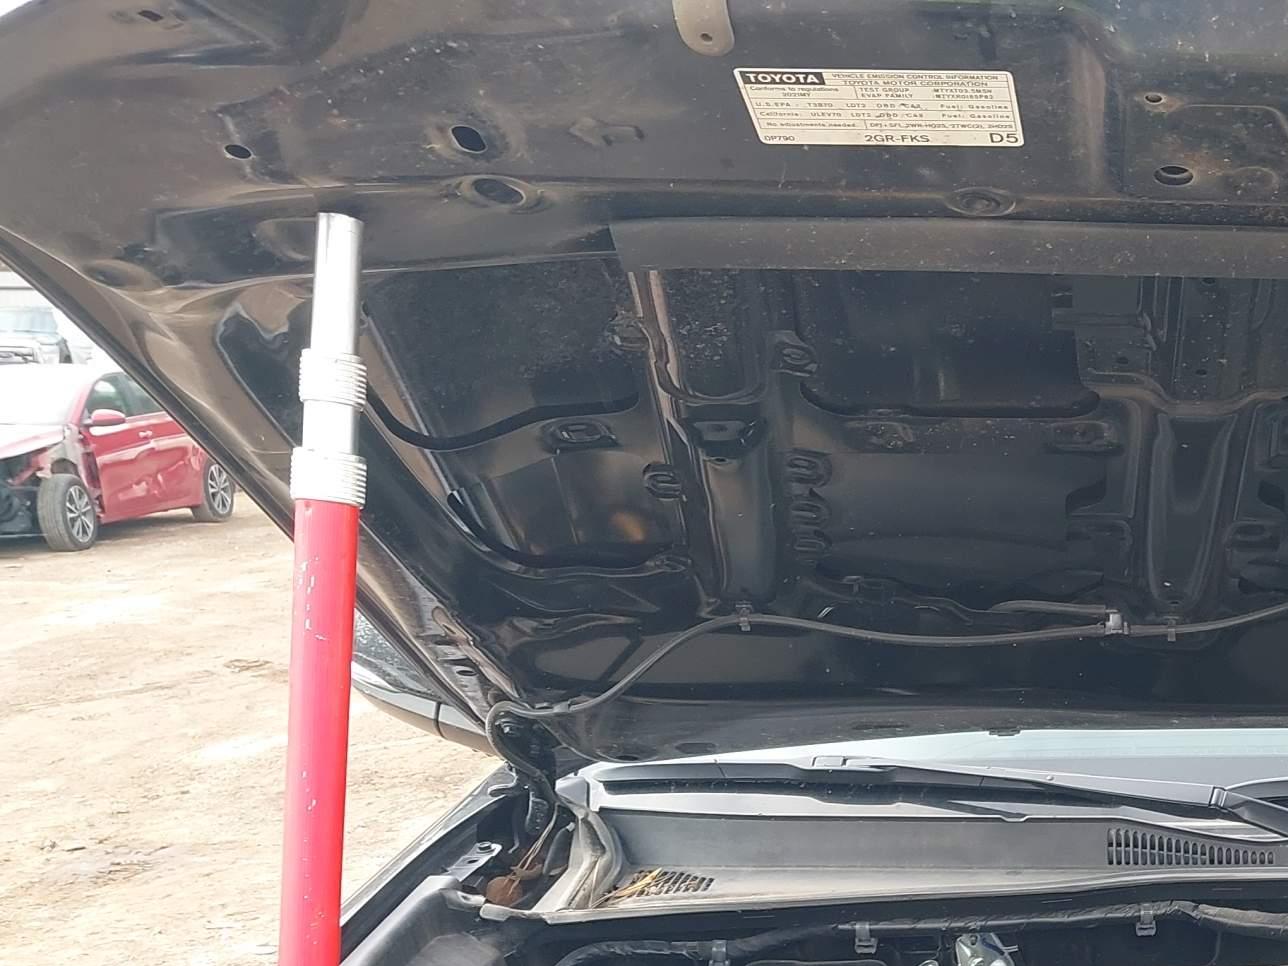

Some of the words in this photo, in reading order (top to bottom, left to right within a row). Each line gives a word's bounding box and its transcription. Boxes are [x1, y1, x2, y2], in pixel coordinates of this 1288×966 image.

[745, 73, 820, 84] TOYOTA
[863, 134, 930, 143] 2GR-FKS
[989, 132, 1019, 143] D5
